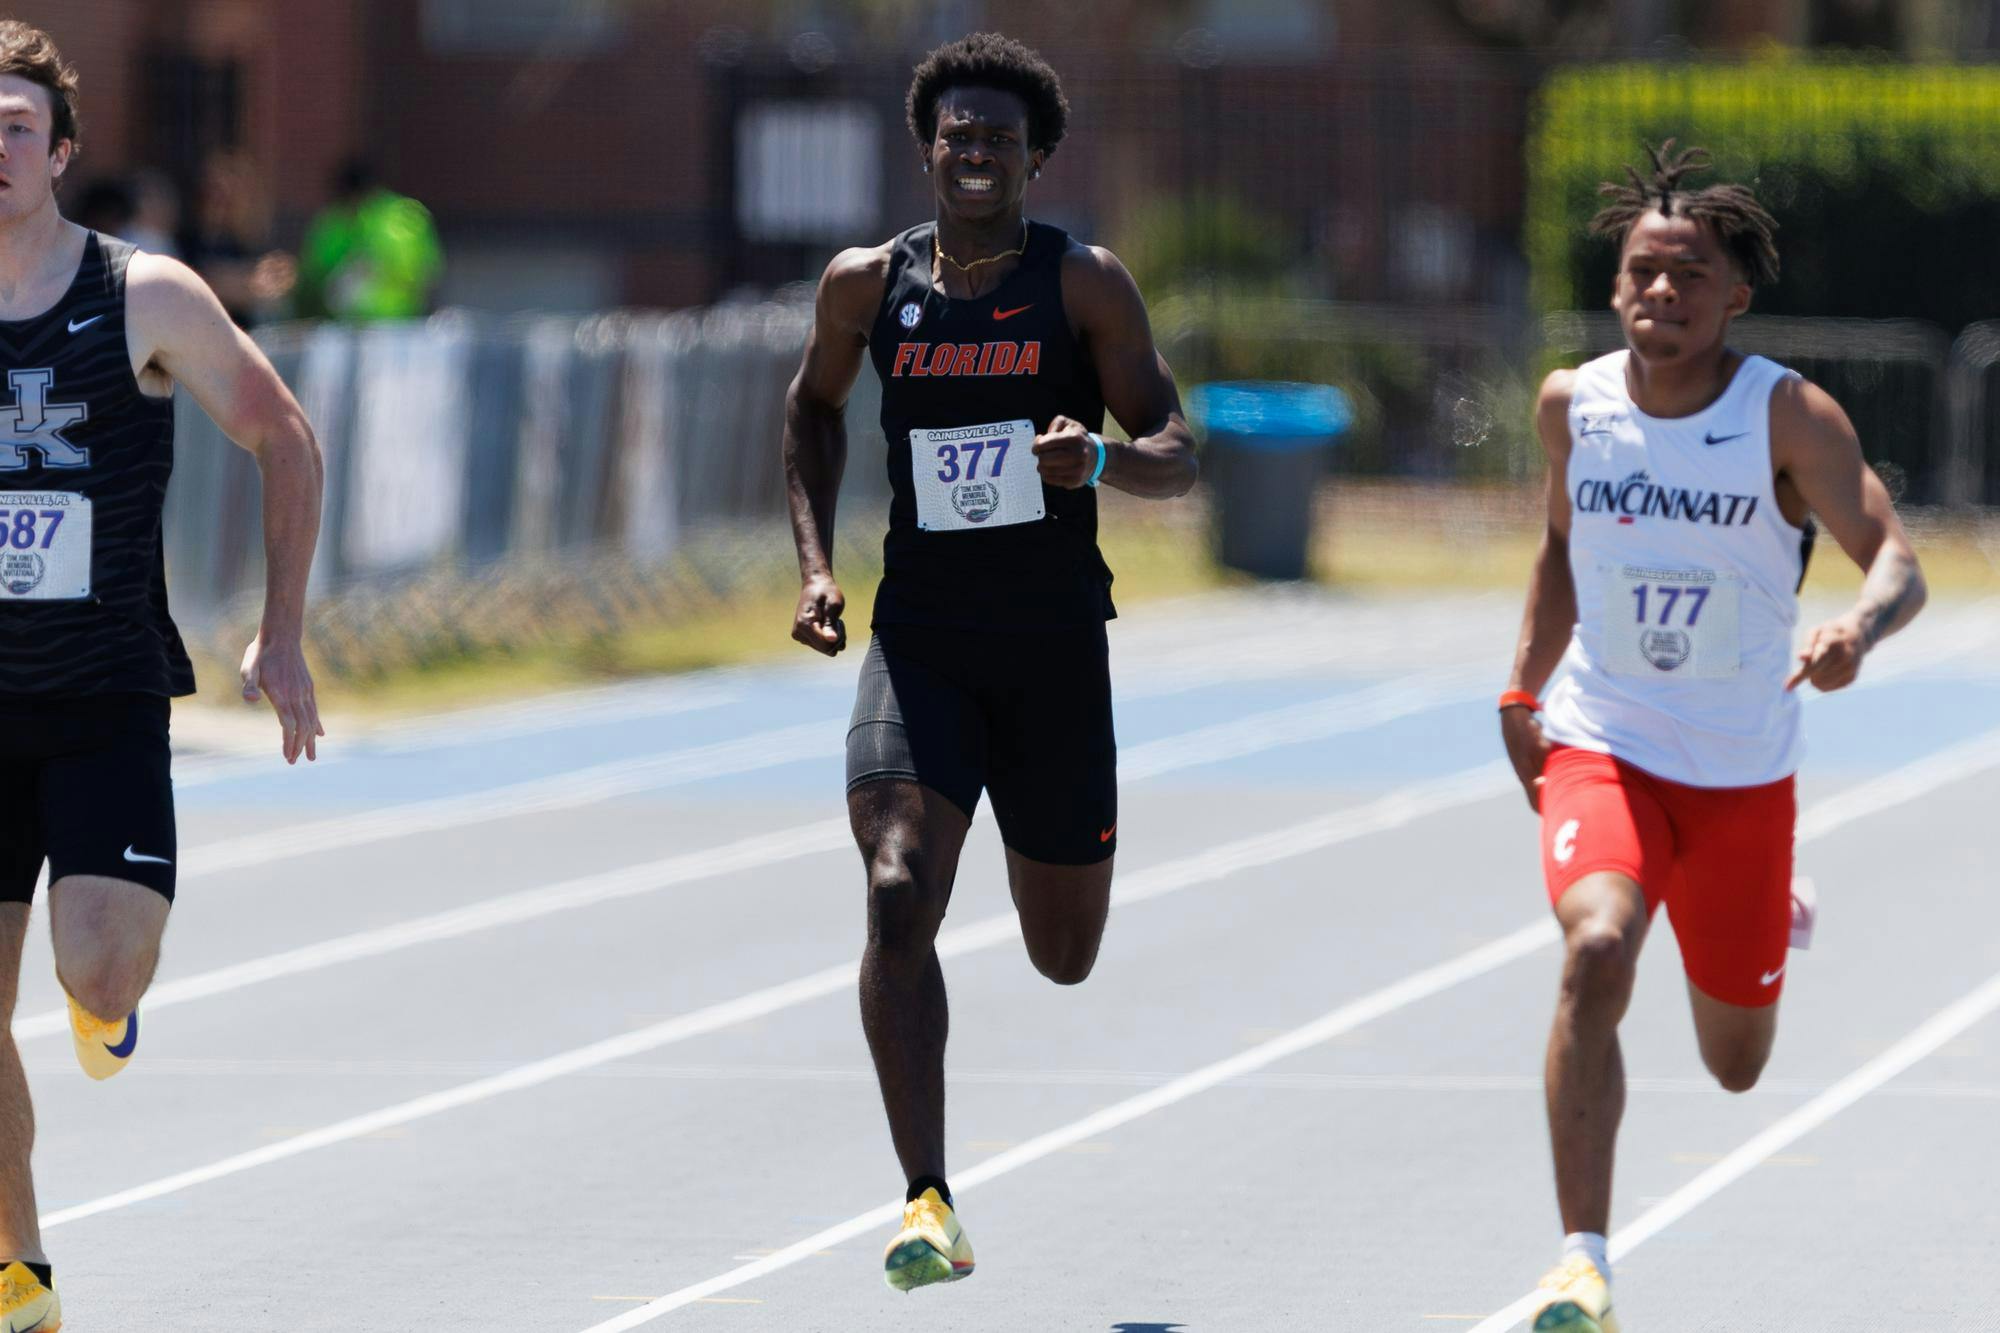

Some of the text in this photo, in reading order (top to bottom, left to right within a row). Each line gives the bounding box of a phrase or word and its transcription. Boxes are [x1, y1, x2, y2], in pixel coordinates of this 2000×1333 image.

[900, 303, 921, 327] SEC
[891, 341, 1041, 377] FLORIDA
[927, 423, 1014, 441] GAINESVILLE, FL
[936, 438, 1011, 483] 377
[54, 495, 70, 505] FL
[1576, 470, 1760, 526] CINCINNATI
[1632, 583, 1711, 626] 177
